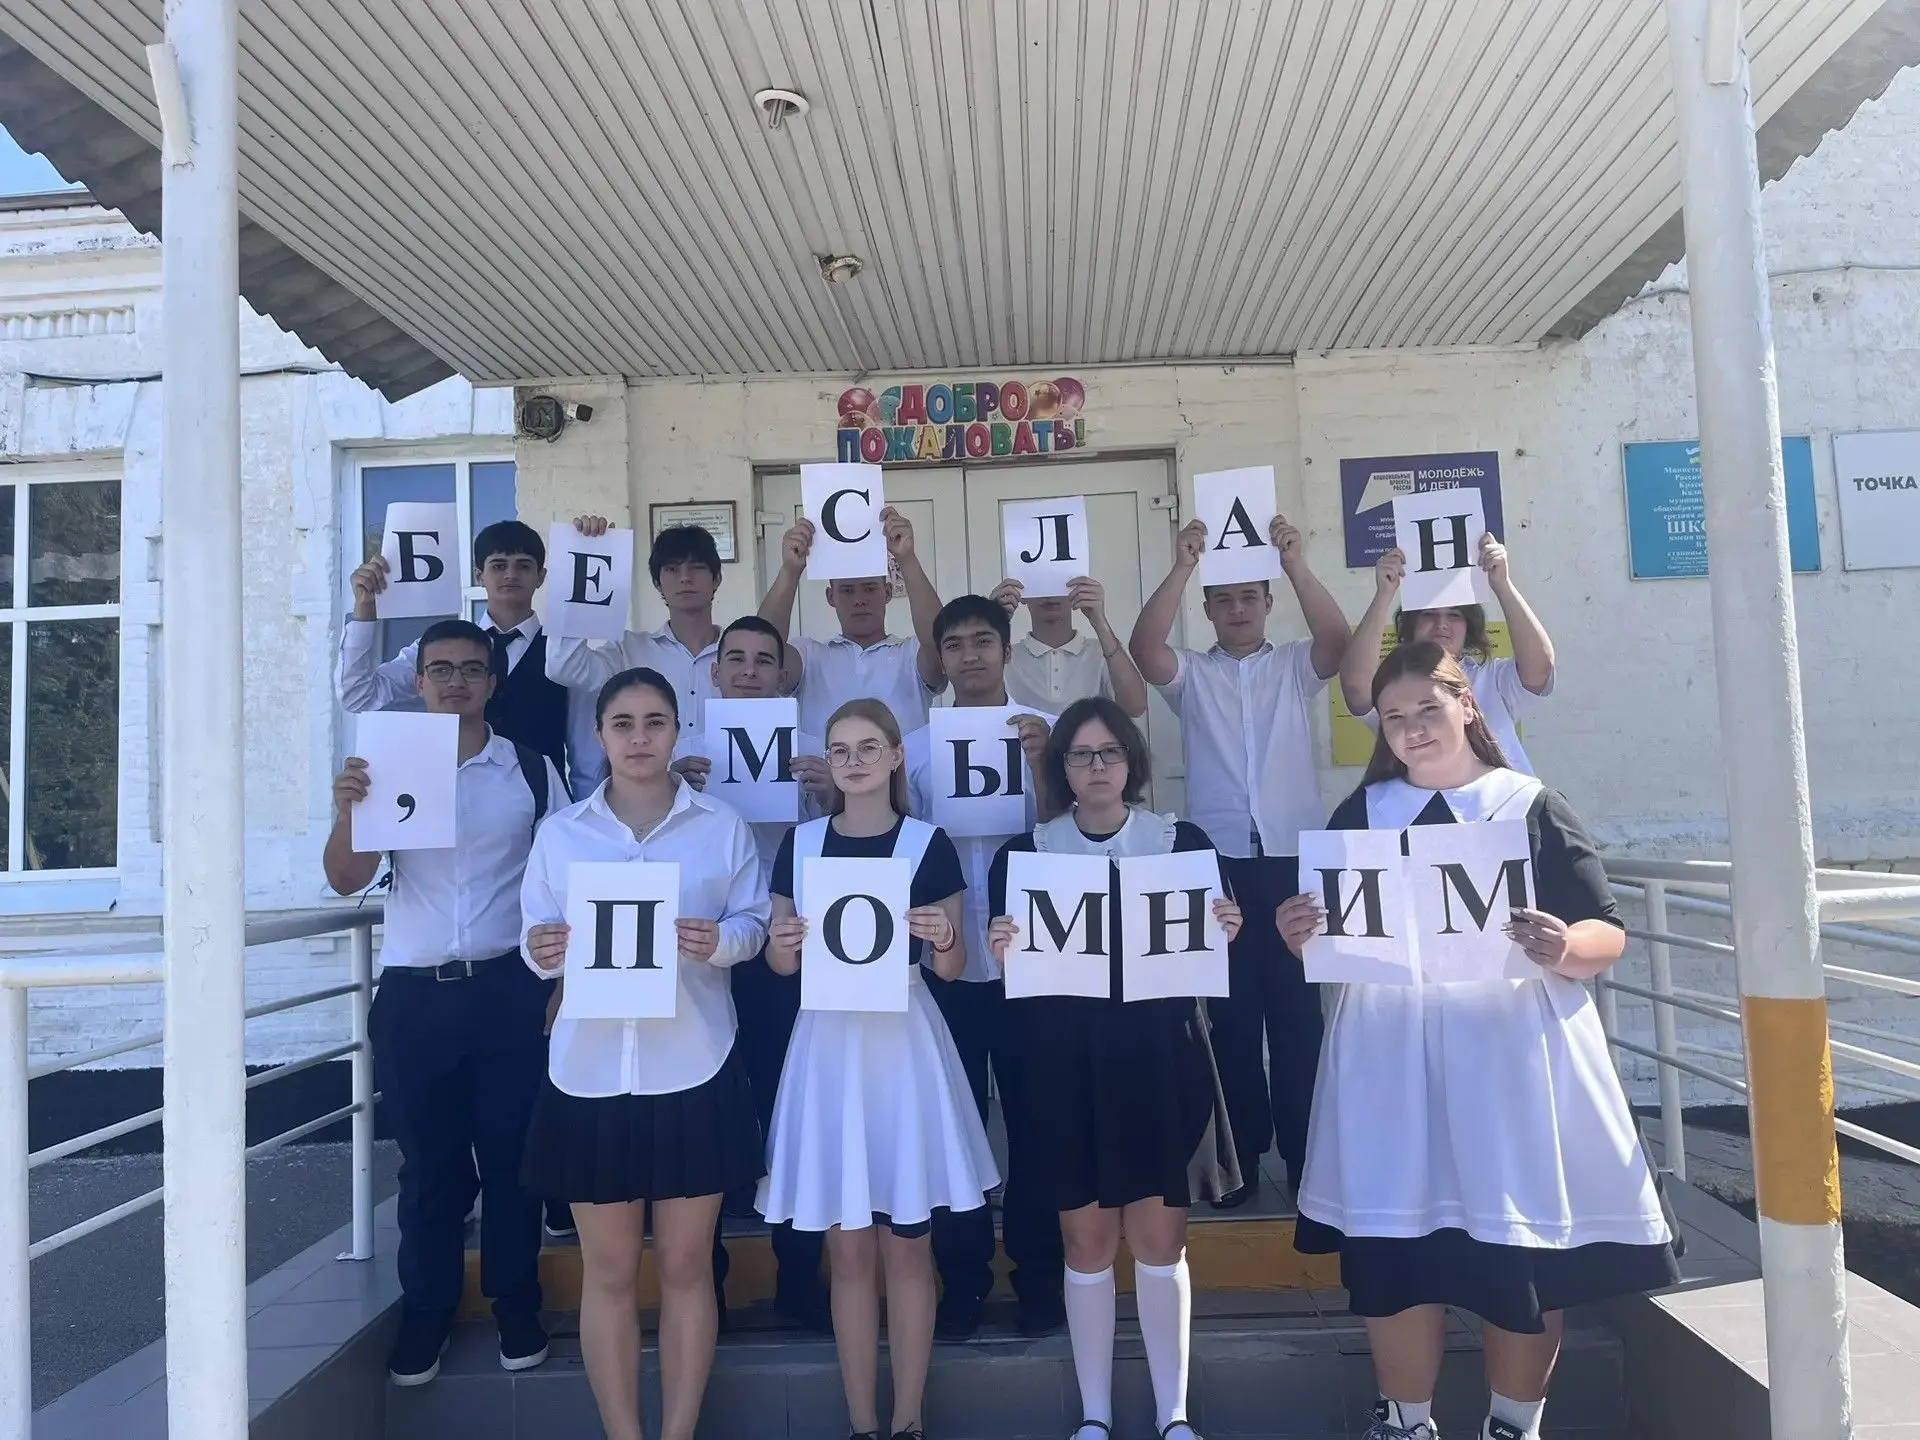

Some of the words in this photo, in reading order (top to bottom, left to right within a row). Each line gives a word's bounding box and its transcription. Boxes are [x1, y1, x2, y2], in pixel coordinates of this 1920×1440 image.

[900, 380, 1029, 425] ДОБРО
[837, 419, 1086, 463] ПОЖАЛОВАТЬ!
[1419, 482, 1428, 492] И
[1430, 480, 1460, 491] ДЕТИ
[1852, 475, 1919, 491] ТОЧКА
[393, 530, 445, 584] Б
[1020, 513, 1077, 564] Л
[945, 737, 1025, 799] Ы
[1313, 868, 1394, 938] И
[585, 900, 665, 970] П
